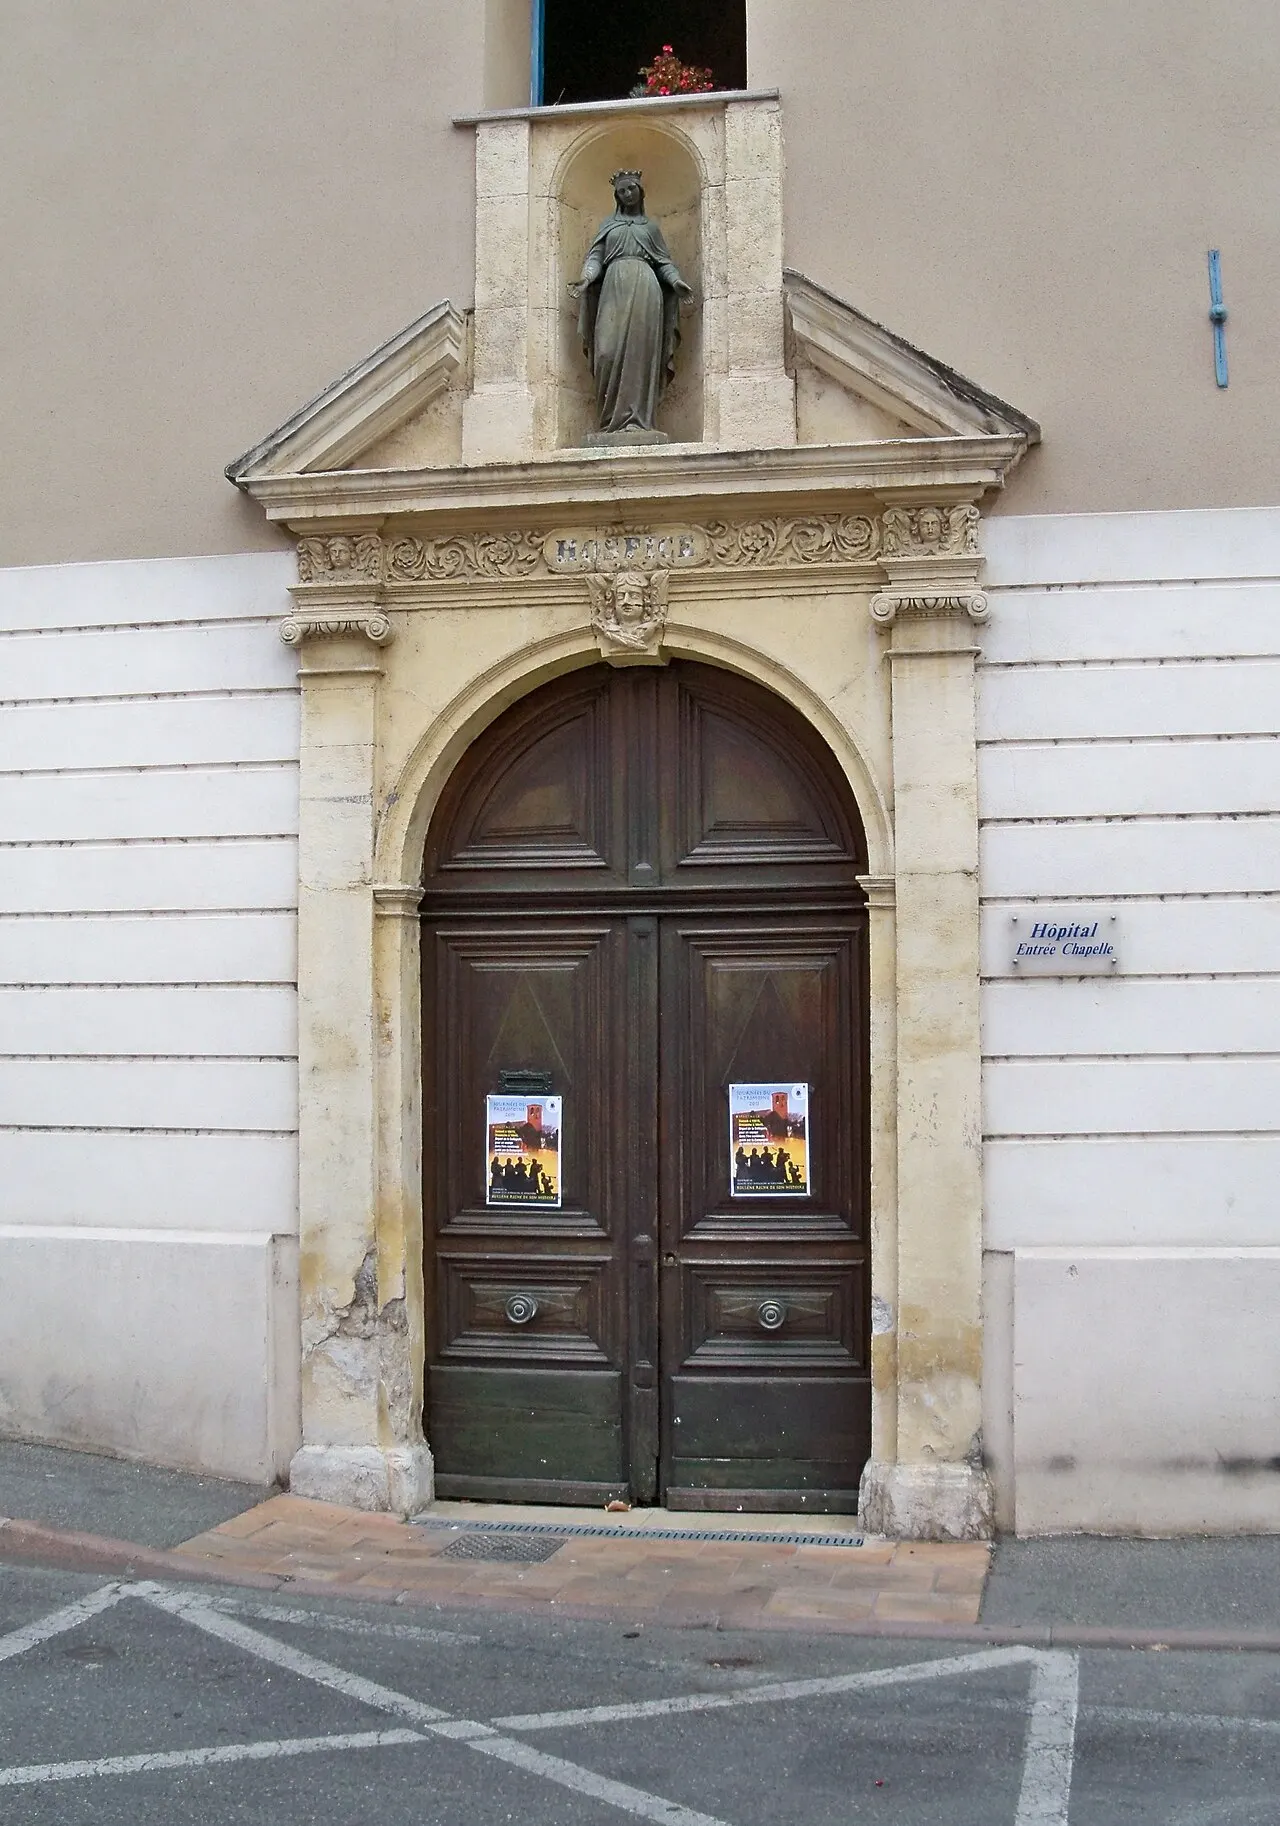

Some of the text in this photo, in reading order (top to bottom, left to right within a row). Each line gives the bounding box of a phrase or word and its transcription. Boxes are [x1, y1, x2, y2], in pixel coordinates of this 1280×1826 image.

[555, 535, 695, 562] HOSPICE
[1030, 922, 1098, 941] Hôpital
[1016, 942, 1114, 957] Entrée Chapelle
